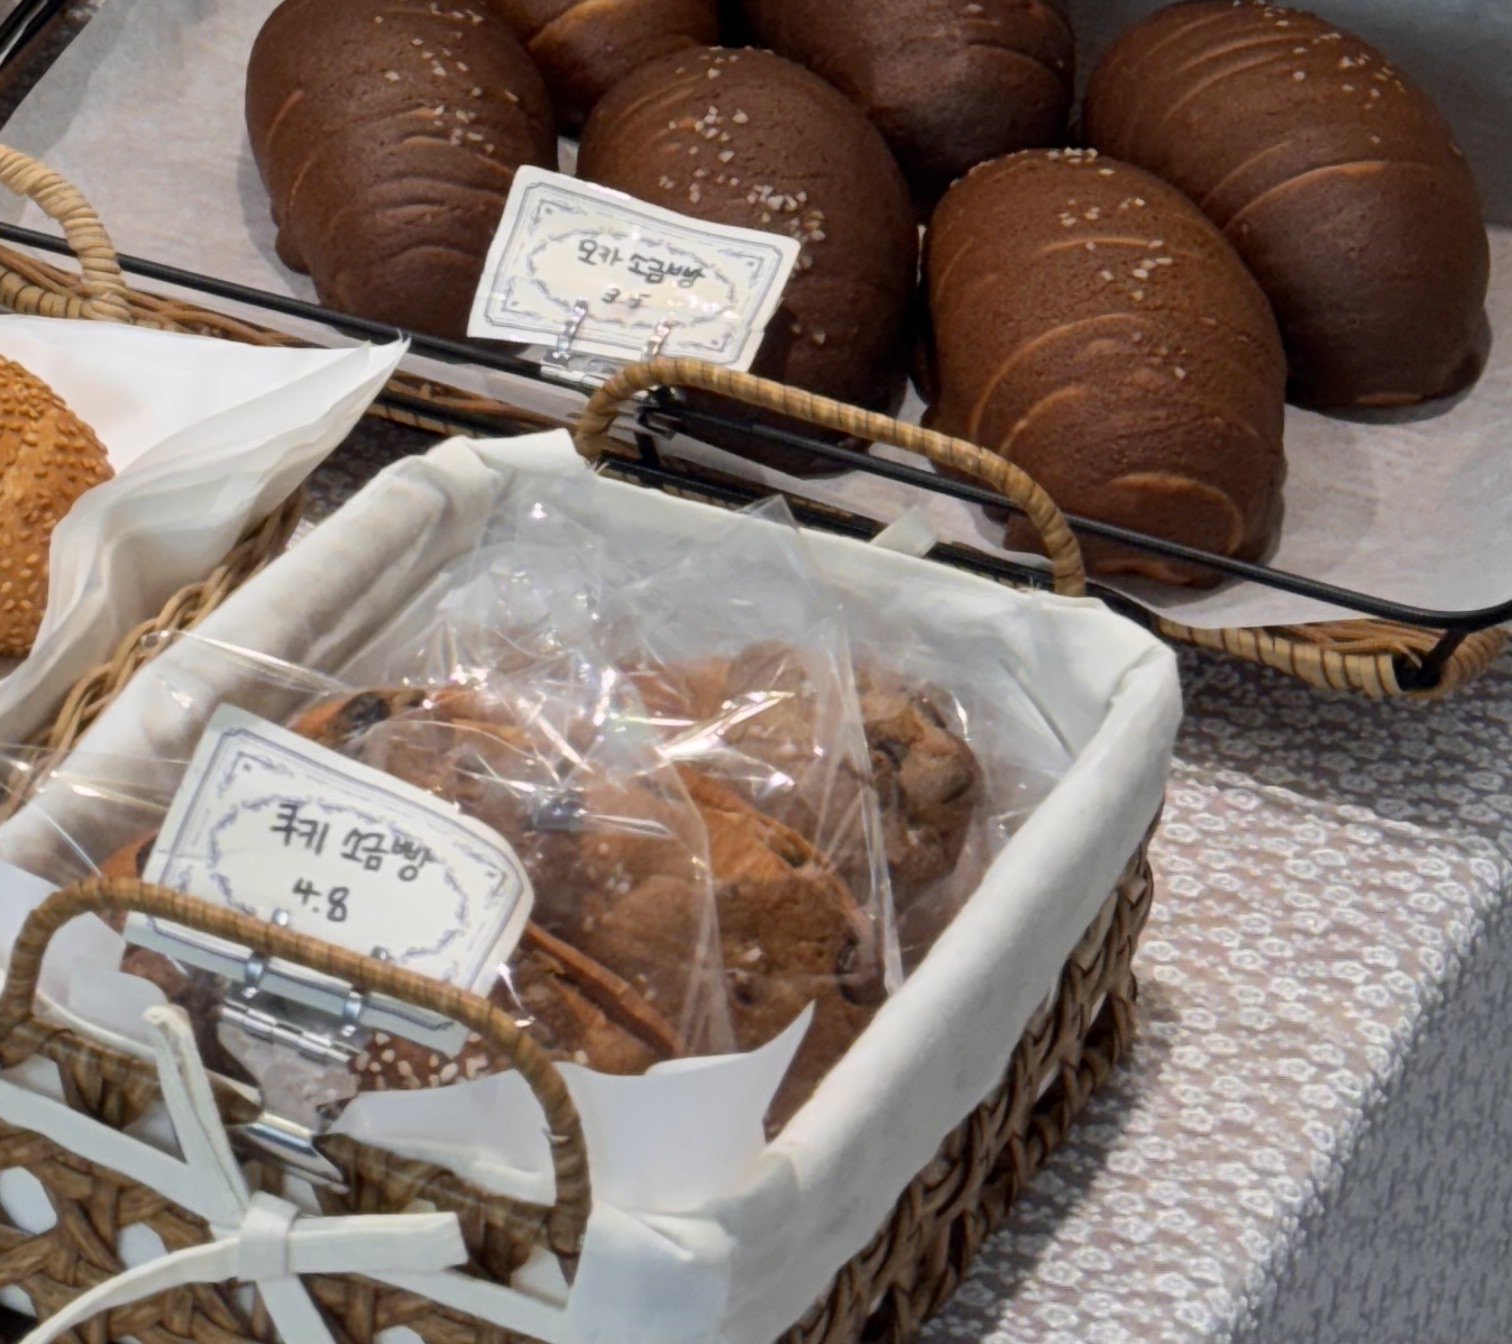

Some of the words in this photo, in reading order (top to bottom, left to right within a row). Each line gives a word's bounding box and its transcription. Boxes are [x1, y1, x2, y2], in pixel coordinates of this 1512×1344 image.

[627, 253, 706, 289] 소금빵
[270, 802, 330, 857] 쿠키
[291, 875, 352, 923] 4.8
